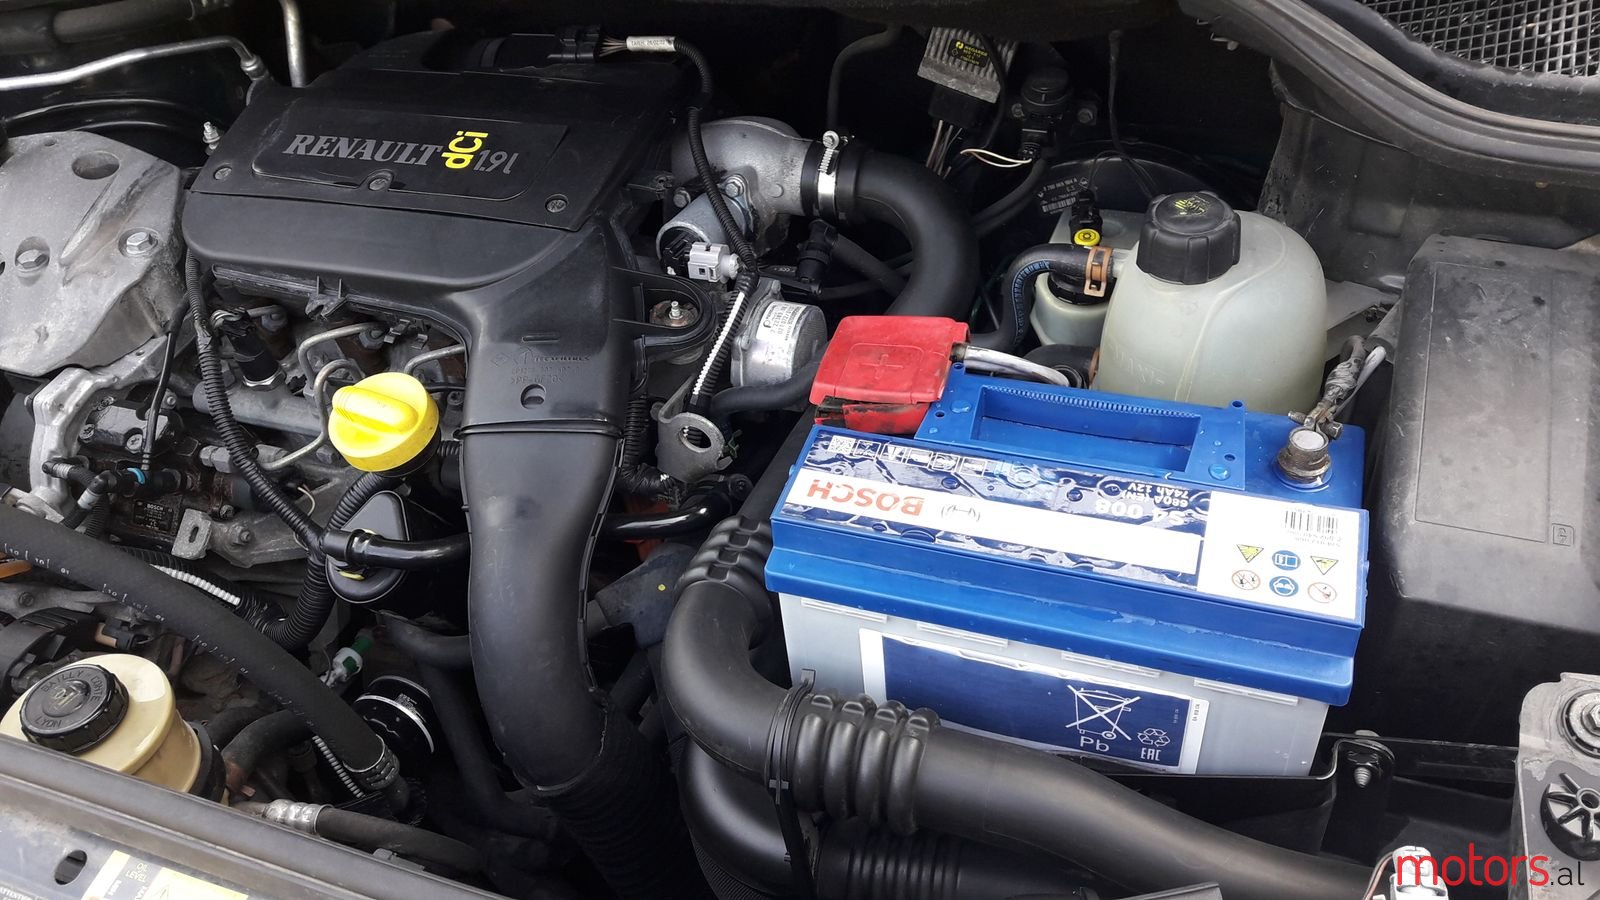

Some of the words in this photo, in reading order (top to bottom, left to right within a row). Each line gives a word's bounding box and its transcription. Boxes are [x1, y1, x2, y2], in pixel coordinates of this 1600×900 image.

[282, 134, 444, 166] RENAULT
[1127, 482, 1153, 493] 12V
[1156, 487, 1190, 498] 74Ah
[807, 479, 925, 516] BOSCH
[1153, 495, 1190, 508] 680A
[1095, 499, 1144, 520] 008
[1151, 508, 1187, 526] S4
[1079, 735, 1110, 752] Pb
[1140, 747, 1162, 761] EAC
